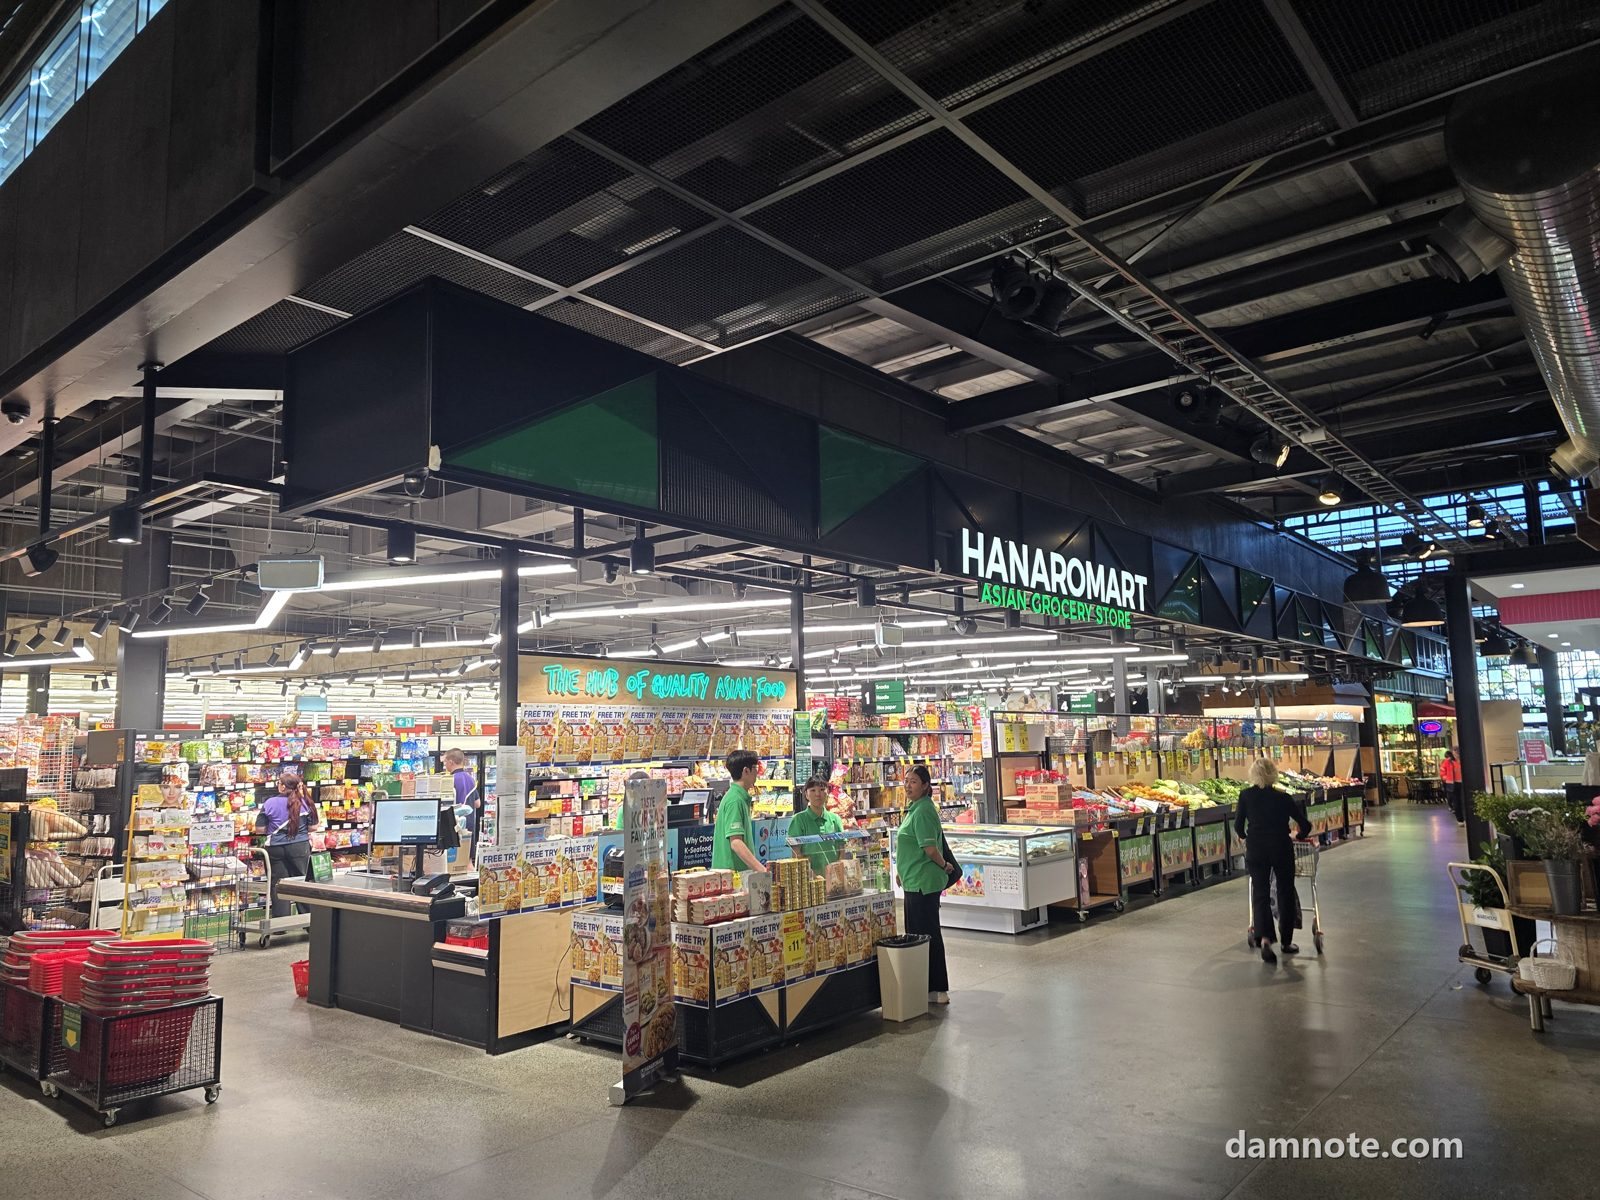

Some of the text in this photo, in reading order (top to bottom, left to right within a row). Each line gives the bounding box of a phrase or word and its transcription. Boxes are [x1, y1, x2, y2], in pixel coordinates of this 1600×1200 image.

[962, 527, 1148, 611] HANAROMART
[980, 582, 1132, 630] ASIAN GROCERY STORE
[543, 664, 581, 694] THE
[586, 668, 619, 698] HUB
[626, 670, 650, 700] OF
[651, 672, 710, 700] QUALITY
[714, 675, 753, 701] ASIAN
[864, 691, 870, 705] 1
[1060, 700, 1069, 712] 4
[229, 721, 235, 732] 3
[684, 836, 699, 845] Why
[526, 848, 558, 859] FREE TRY
[564, 844, 595, 854] FREE TRY
[684, 844, 712, 854] K-Seafood
[482, 852, 518, 864] FREE TRY
[846, 907, 858, 916] FREE
[817, 913, 830, 922] FREE
[573, 921, 600, 932] FREE TRY
[606, 925, 620, 934] FREE
[752, 923, 780, 936] FREE TRY
[675, 934, 706, 946] FREE TRY
[716, 930, 746, 944] FREE TRY
